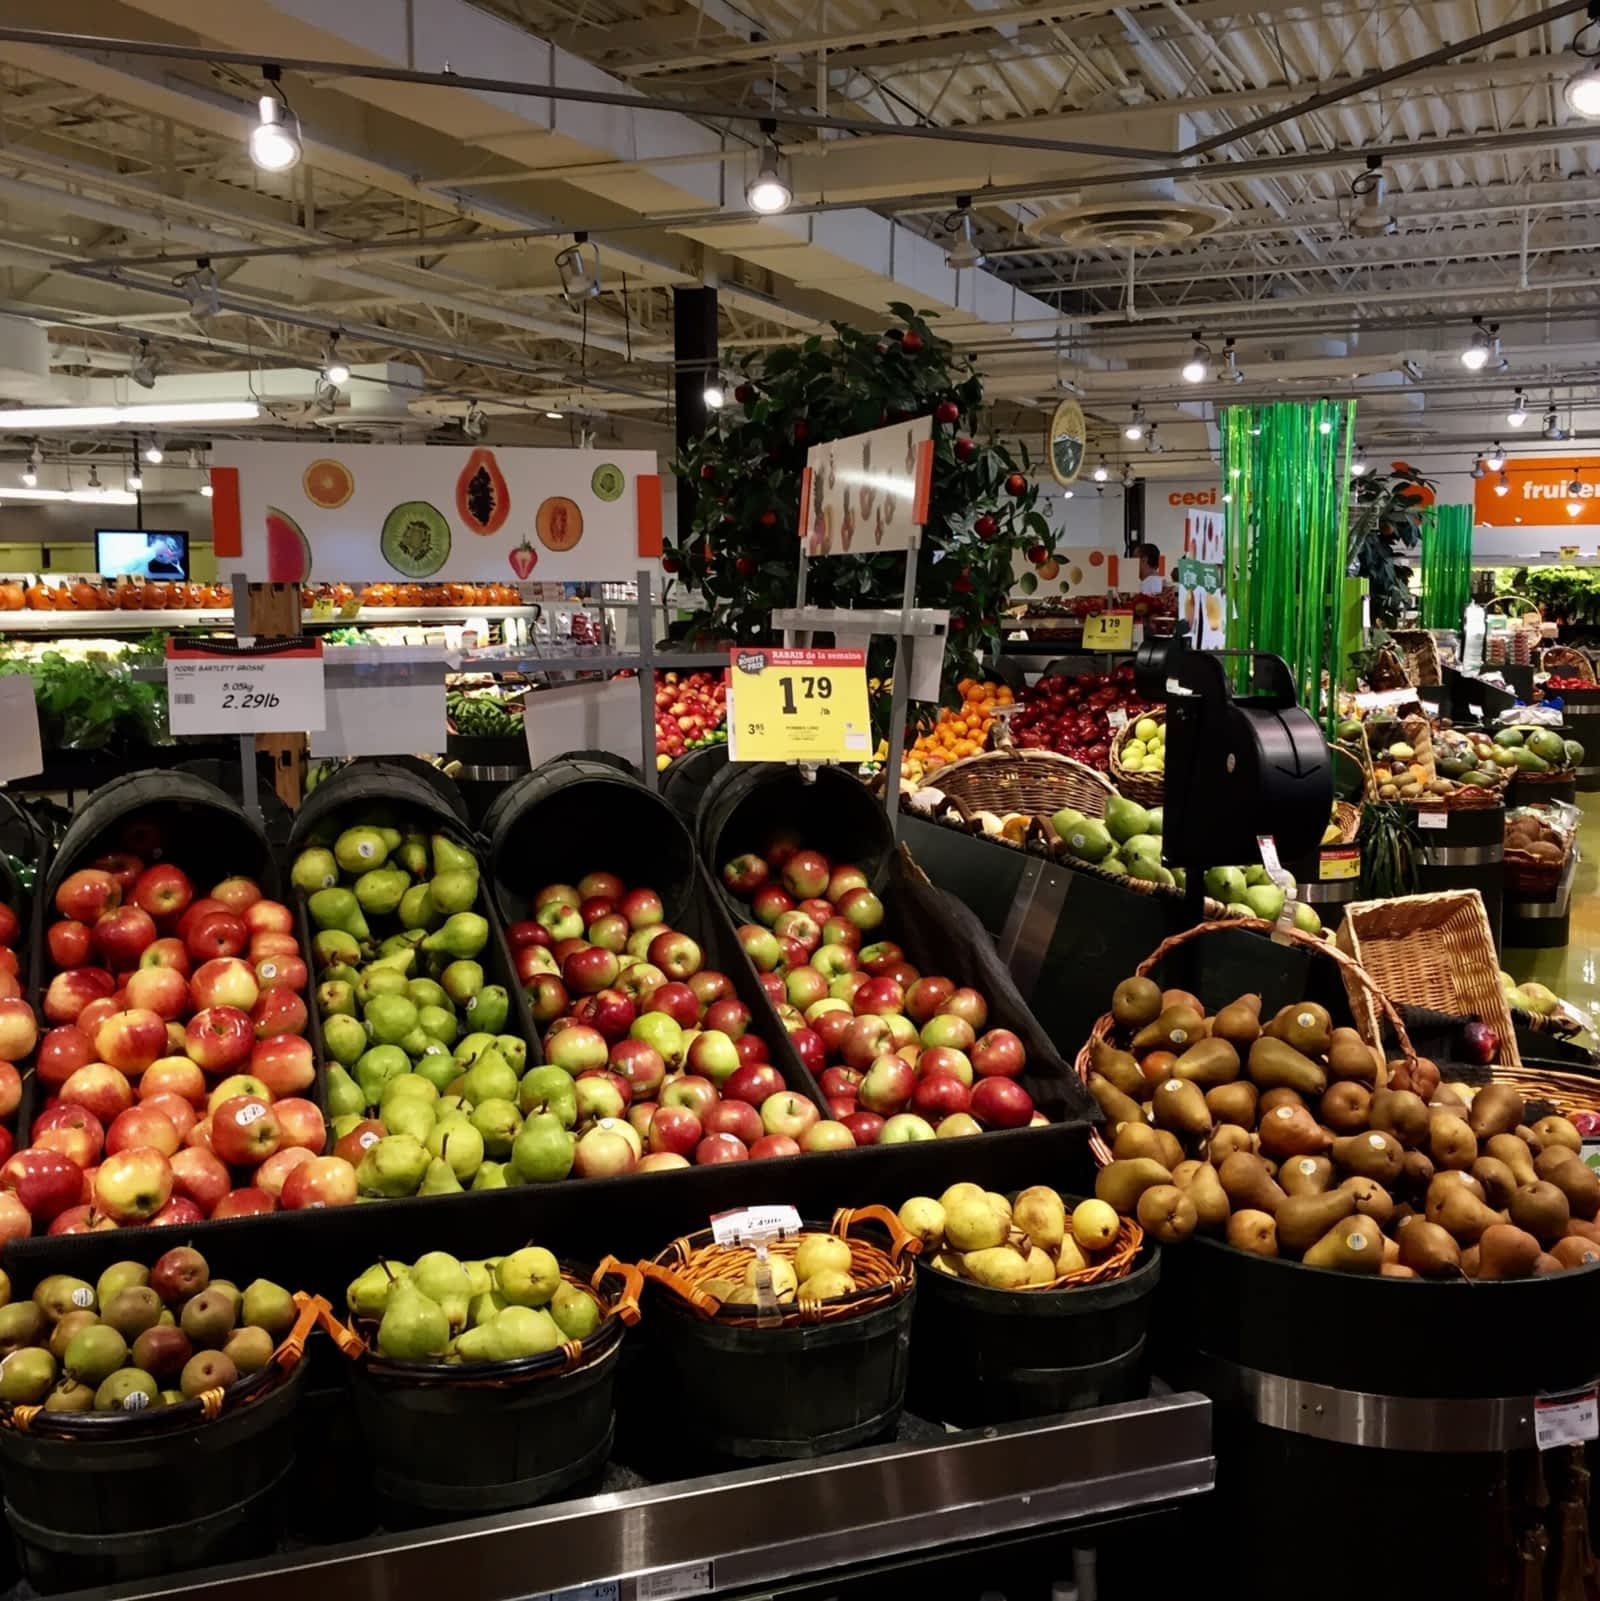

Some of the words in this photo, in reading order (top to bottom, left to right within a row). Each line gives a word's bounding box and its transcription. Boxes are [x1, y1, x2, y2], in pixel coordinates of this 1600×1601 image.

[1168, 488, 1217, 506] ceci
[771, 651, 804, 659] RABAIS
[827, 652, 862, 660] semaine
[198, 664, 234, 672] BARTLETT
